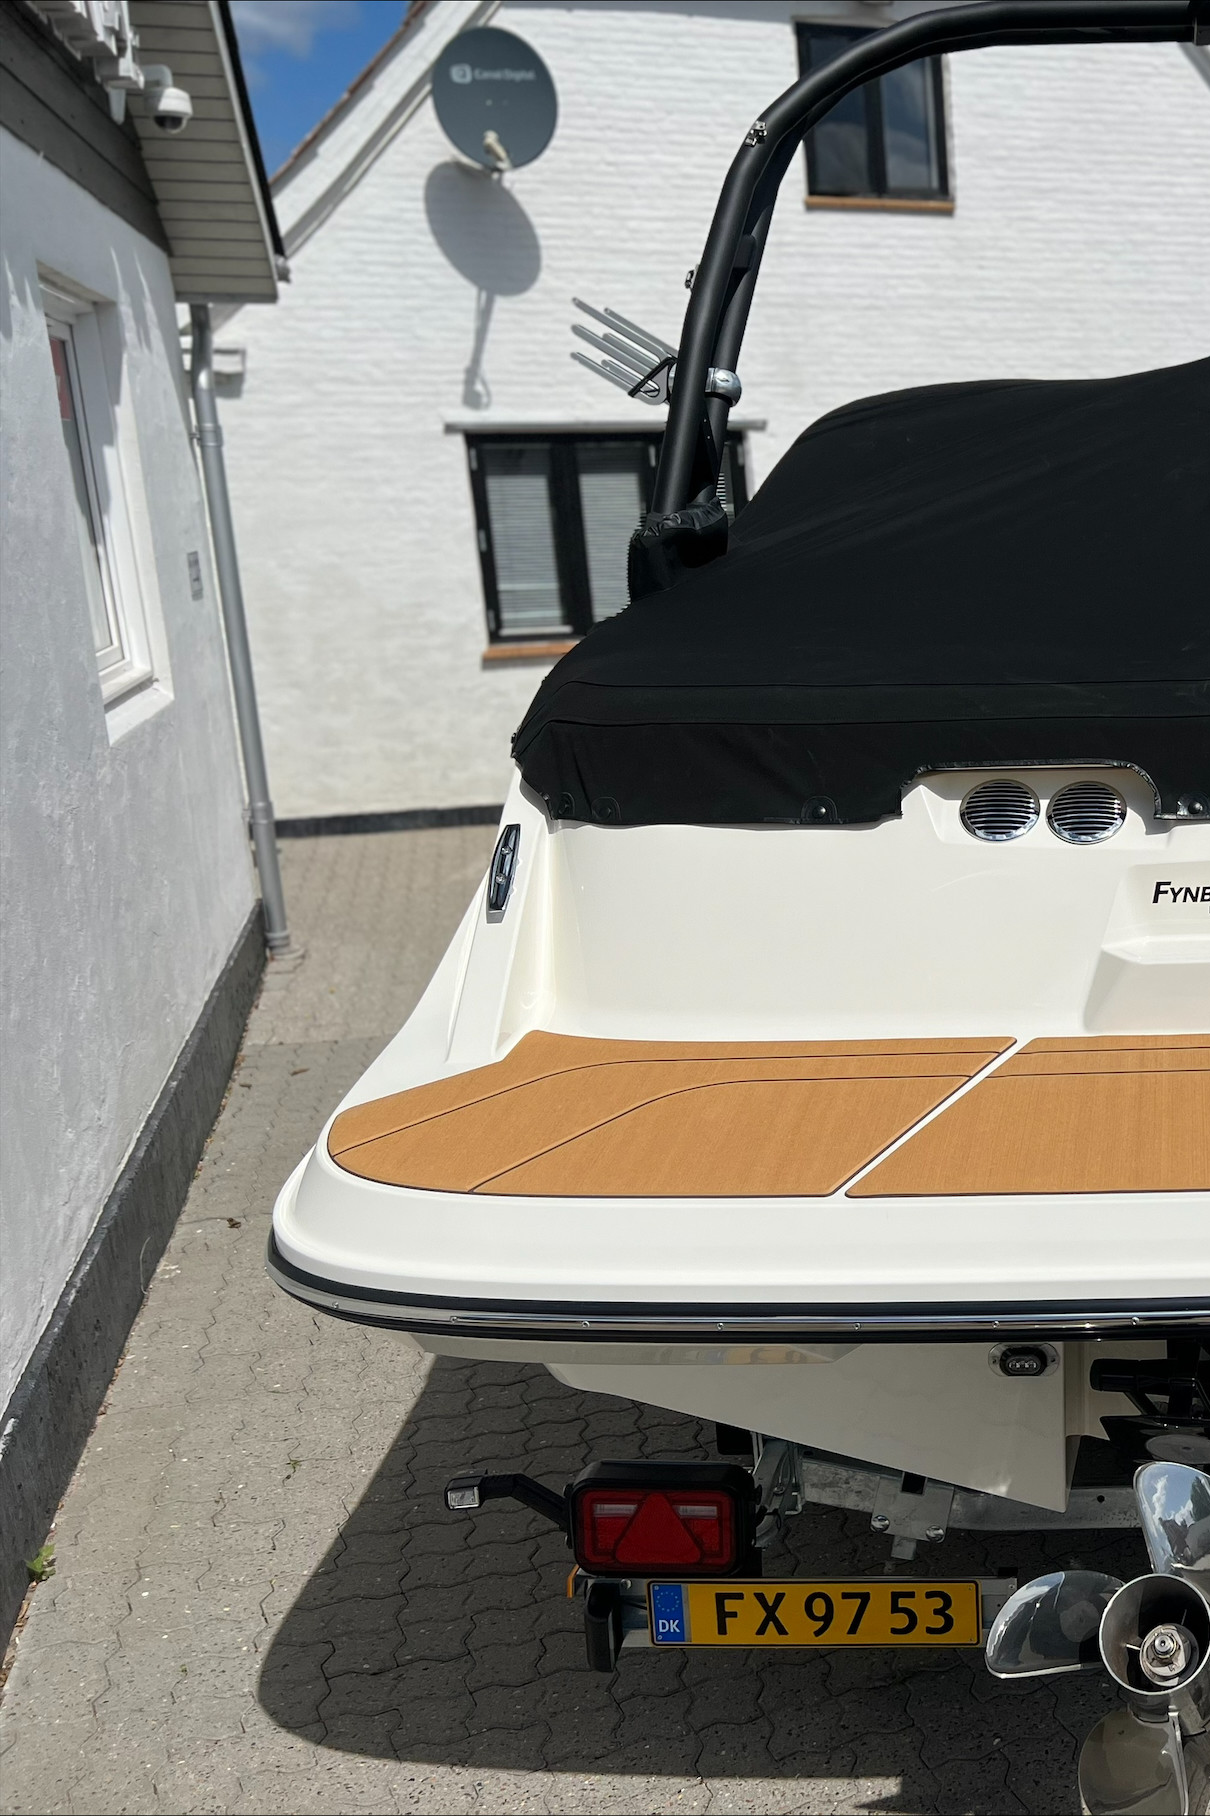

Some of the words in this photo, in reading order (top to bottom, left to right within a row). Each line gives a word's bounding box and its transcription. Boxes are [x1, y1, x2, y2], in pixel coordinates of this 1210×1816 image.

[658, 1619, 681, 1633] DK
[714, 1592, 789, 1636] FX
[803, 1591, 871, 1638] 97
[889, 1590, 954, 1635] 53
